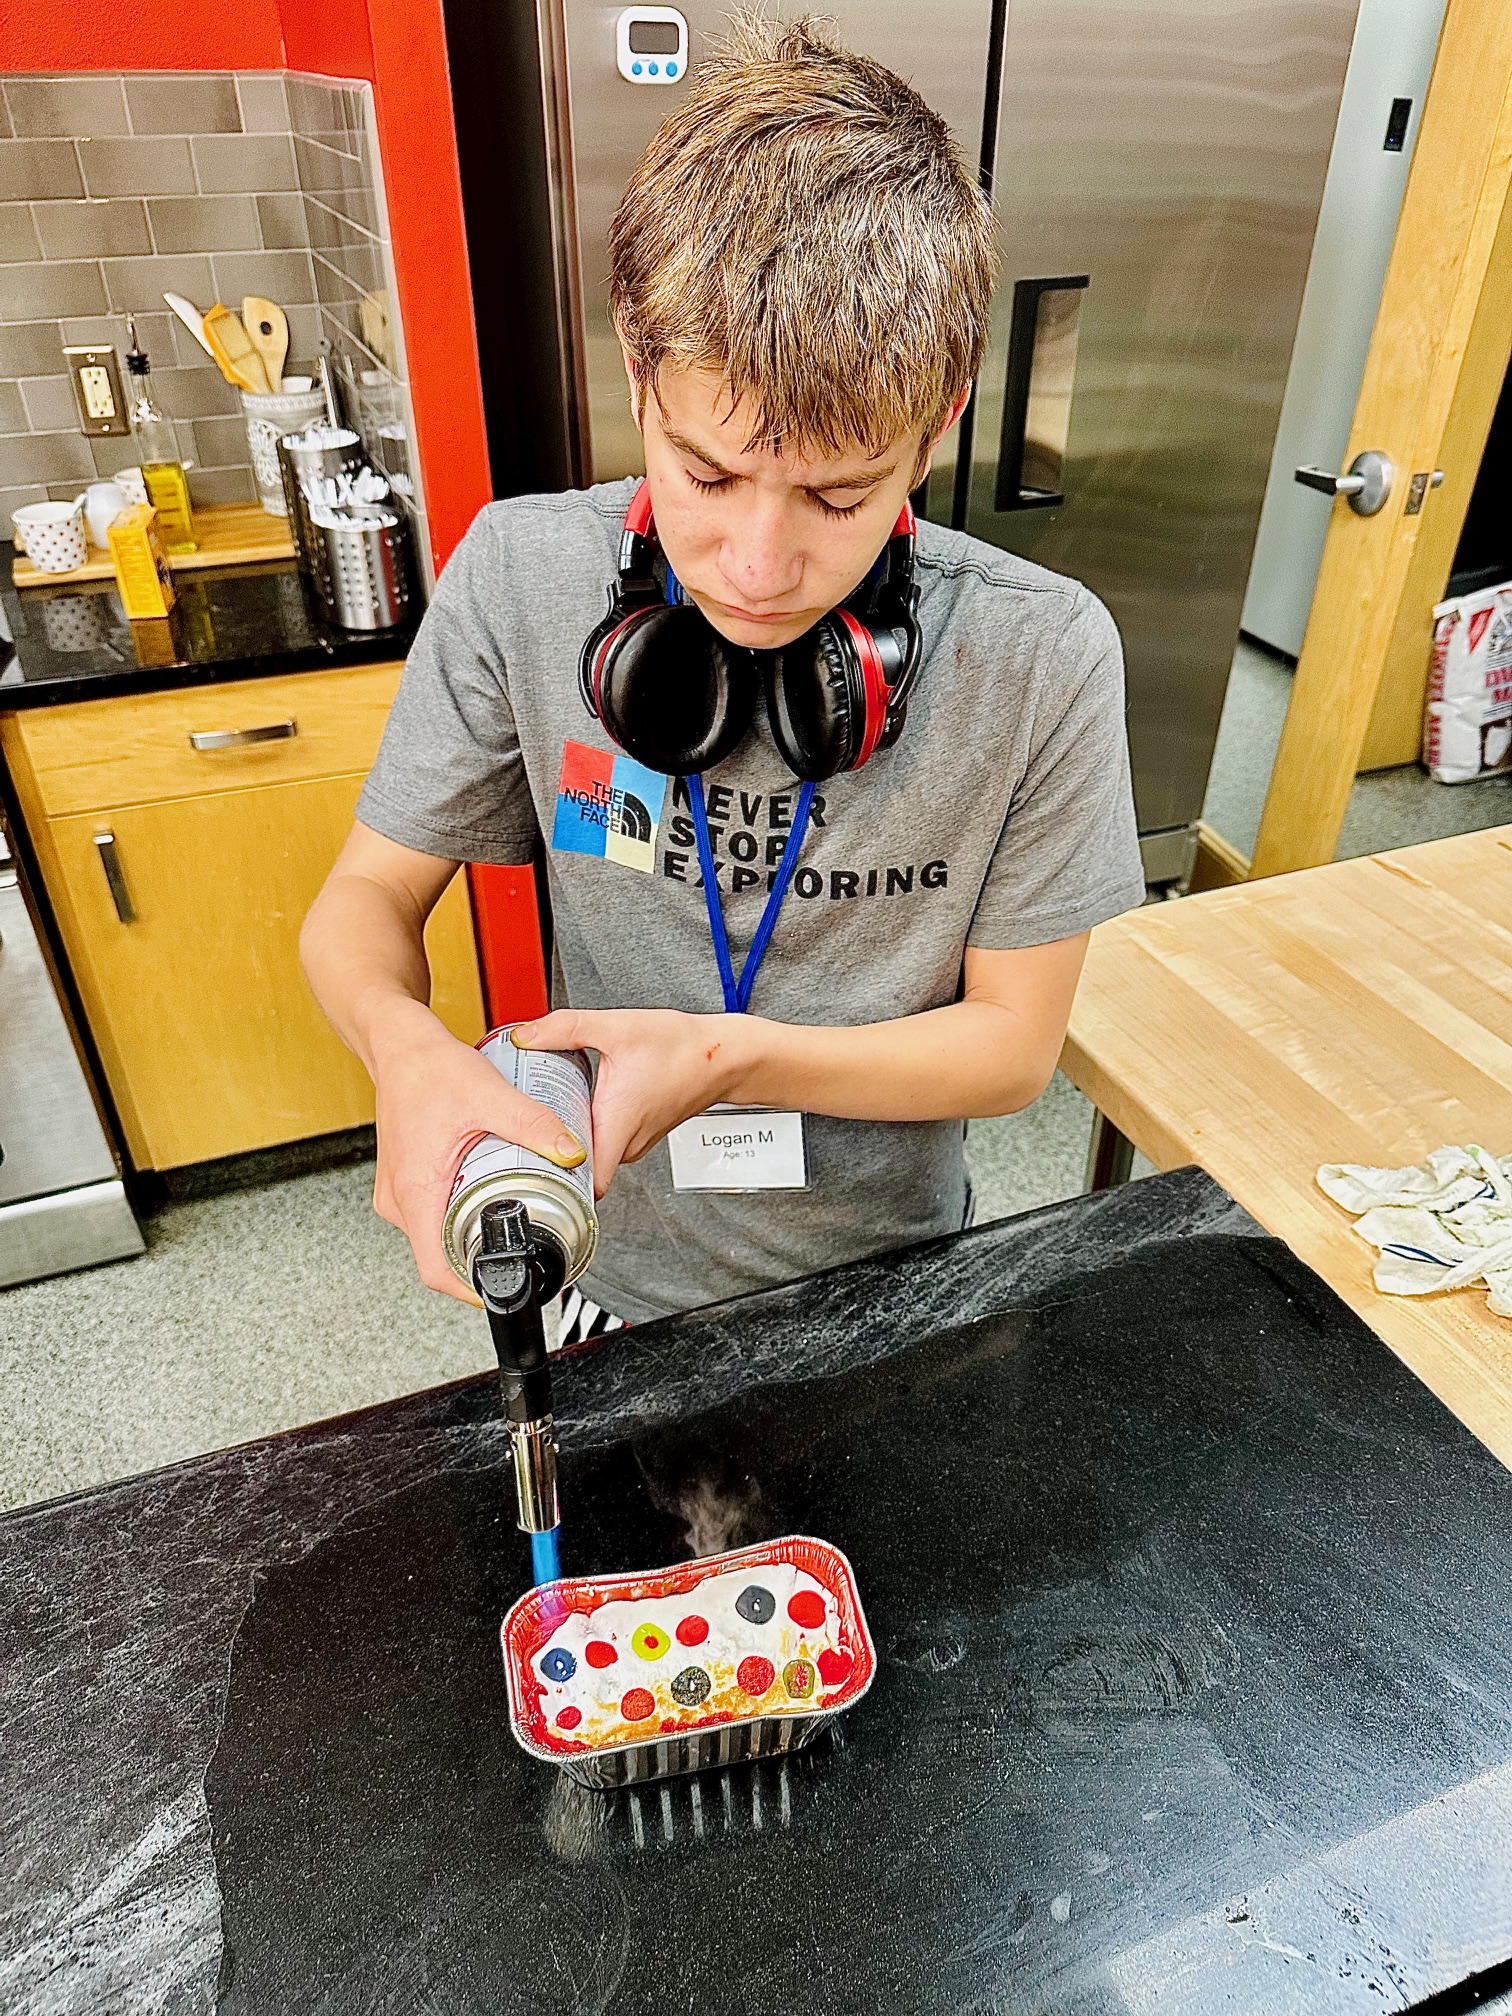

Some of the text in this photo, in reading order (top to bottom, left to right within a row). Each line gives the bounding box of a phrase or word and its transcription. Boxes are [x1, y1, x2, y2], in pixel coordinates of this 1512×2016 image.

[563, 787, 622, 818] NORTH
[592, 780, 624, 805] THE
[672, 778, 827, 829] NEVER
[580, 806, 621, 834] FACE
[668, 815, 790, 866] STOP
[701, 1130, 774, 1148] Logan M
[723, 1149, 756, 1161] Age: 13
